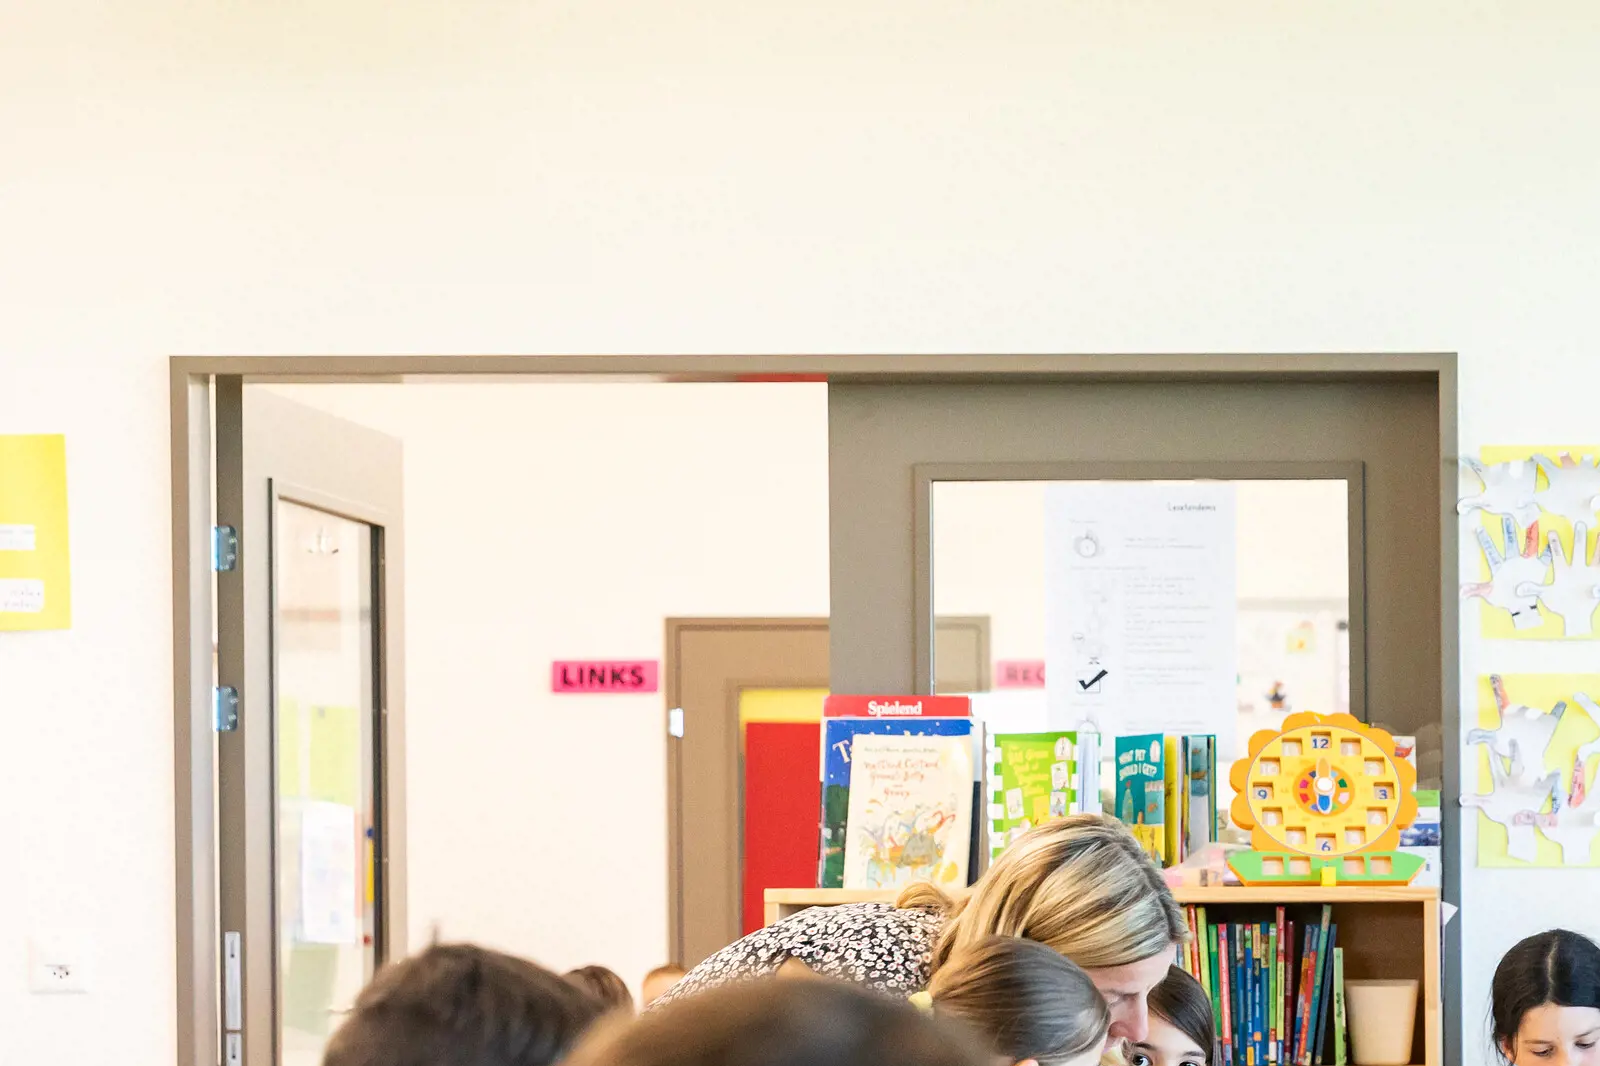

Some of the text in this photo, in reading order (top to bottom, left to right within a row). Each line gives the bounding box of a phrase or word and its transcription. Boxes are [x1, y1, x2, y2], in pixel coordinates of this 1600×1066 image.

[562, 665, 645, 687] LINKS
[868, 701, 922, 717] Spielend
[1312, 738, 1329, 749] 12
[1257, 789, 1268, 800] 9
[1378, 789, 1388, 800] 3
[1321, 841, 1331, 851] 6
